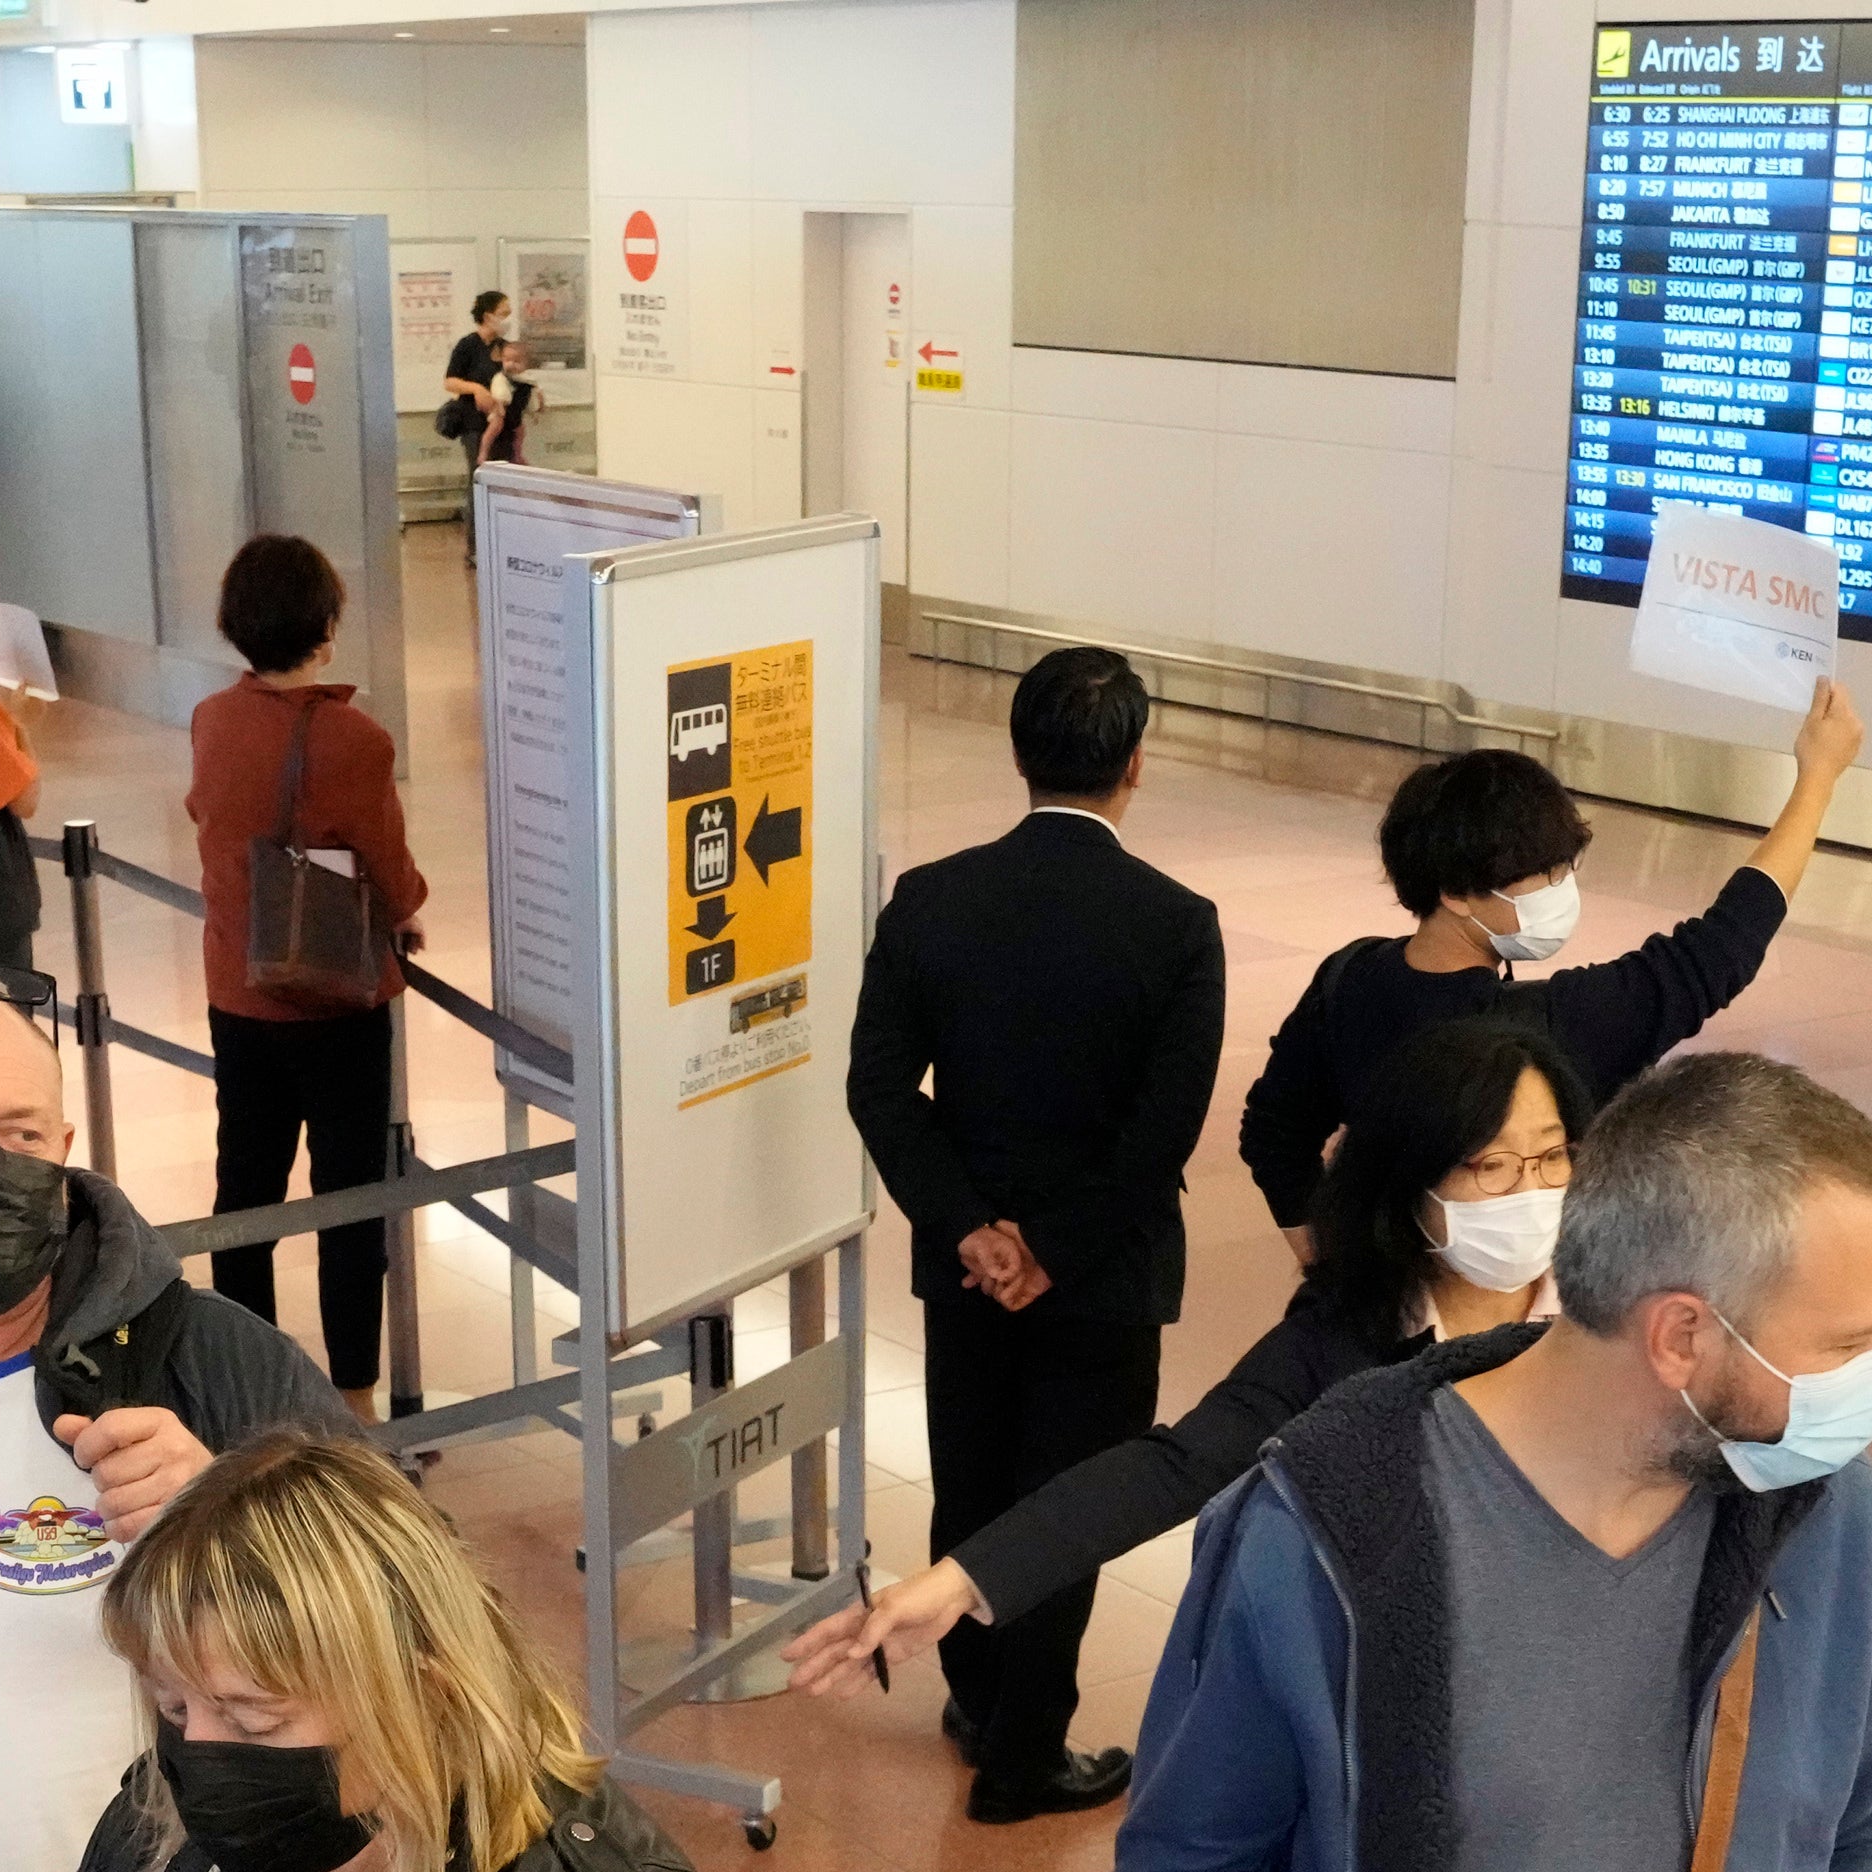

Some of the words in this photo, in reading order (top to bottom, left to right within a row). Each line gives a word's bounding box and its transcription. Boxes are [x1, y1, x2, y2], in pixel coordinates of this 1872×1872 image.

[1639, 36, 1740, 73] Arrivals
[1604, 106, 1631, 123] 6:30
[1643, 106, 1670, 123] 6:25
[1678, 106, 1736, 124] SHANGHAI
[1737, 107, 1786, 124] PUDONG
[1754, 132, 1782, 149] CITY
[1600, 154, 1628, 172] 8:10
[1674, 156, 1752, 175] FRANKFURT
[1638, 179, 1666, 197] 7:57
[1672, 181, 1728, 199] MUNICH
[1671, 205, 1730, 225] JAKARTA
[1596, 228, 1623, 246] 9:45
[1670, 230, 1746, 251] FRANKFURT
[1668, 256, 1749, 276] SEOUL(GMP)
[1588, 276, 1619, 294] 10:45
[1666, 280, 1747, 300] SEOUL(GMP)
[1586, 300, 1618, 318] 11:10
[1664, 304, 1746, 326] SEOUL(GMP)
[1658, 400, 1716, 421] HELSINKI
[1656, 425, 1708, 446] MANILA
[1654, 449, 1694, 470] HONG
[1696, 453, 1736, 473] KONG
[1654, 472, 1680, 492] SAN
[1681, 476, 1753, 500] FRANCISCO
[1671, 553, 1758, 601] VISTA
[1766, 575, 1827, 619] SMC
[1791, 647, 1813, 662] KEN
[737, 653, 806, 688] ターミナル間
[701, 953, 721, 983] 1F
[707, 1402, 785, 1477] TIAT
[36, 1526, 58, 1542] USA
[35, 1551, 116, 1585] Motorcycles
